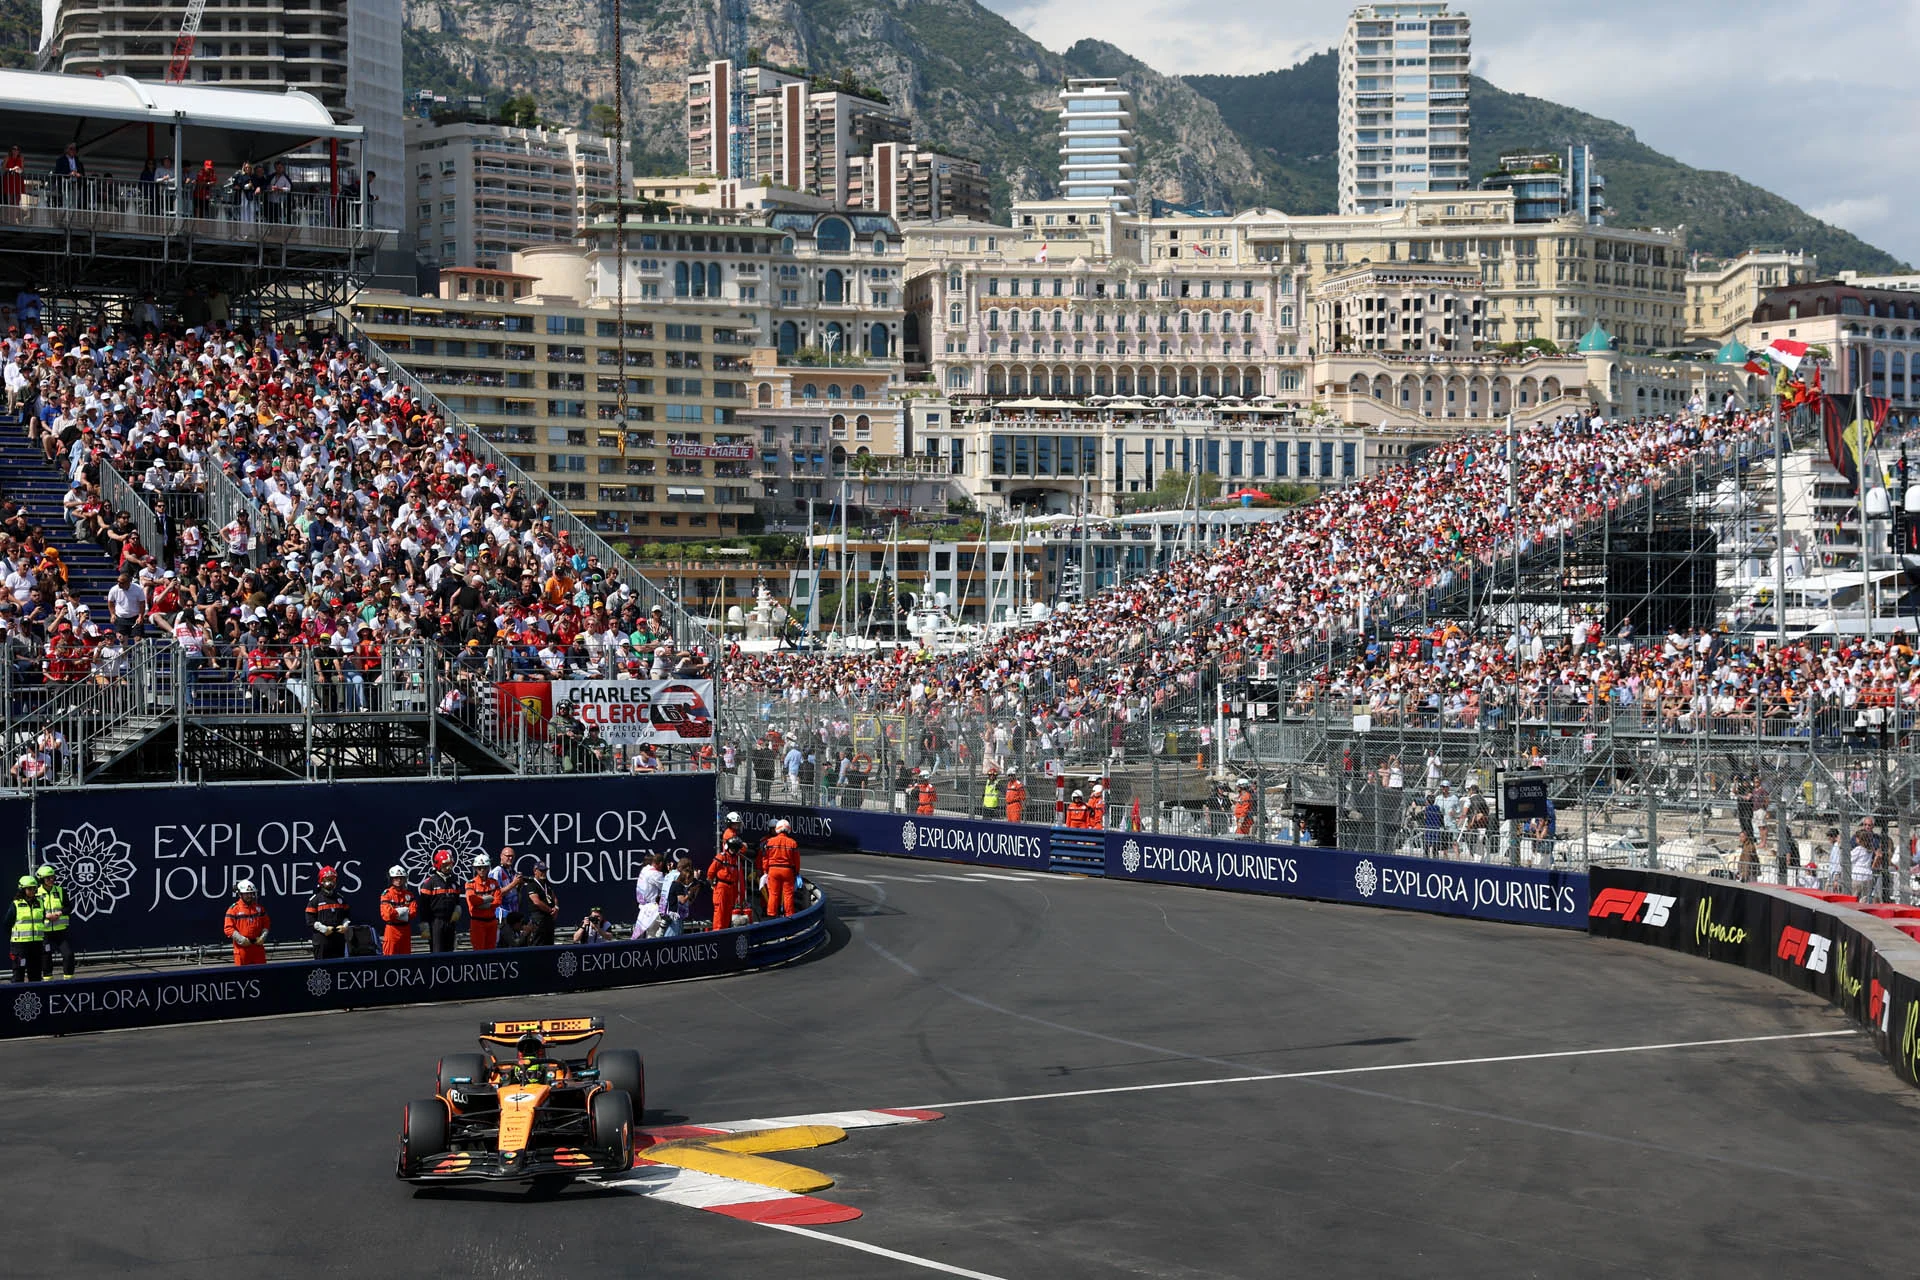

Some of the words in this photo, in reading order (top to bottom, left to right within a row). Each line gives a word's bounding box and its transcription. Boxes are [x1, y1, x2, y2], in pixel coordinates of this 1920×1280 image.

[569, 687, 651, 703] CHARLES
[573, 704, 649, 724] ECLERC
[154, 820, 348, 860] EXPLORA
[504, 810, 677, 847] EXPLORA
[919, 826, 974, 852] EXPLORA
[976, 831, 1041, 859] JOURNEYS
[1144, 846, 1213, 875] EXPLORA
[1216, 852, 1298, 883] JOURNEYS
[1382, 868, 1469, 903] EXPLORA
[1472, 878, 1576, 914] JOURNEYS
[1695, 896, 1747, 945] Monaco
[582, 950, 653, 972] EXPLORA
[655, 942, 718, 969] JOURNEYS
[337, 967, 425, 990] EXPLORA
[429, 961, 519, 990] JOURNEYS
[49, 988, 150, 1014] EXPLORA
[155, 979, 261, 1012] JOURNEYS
